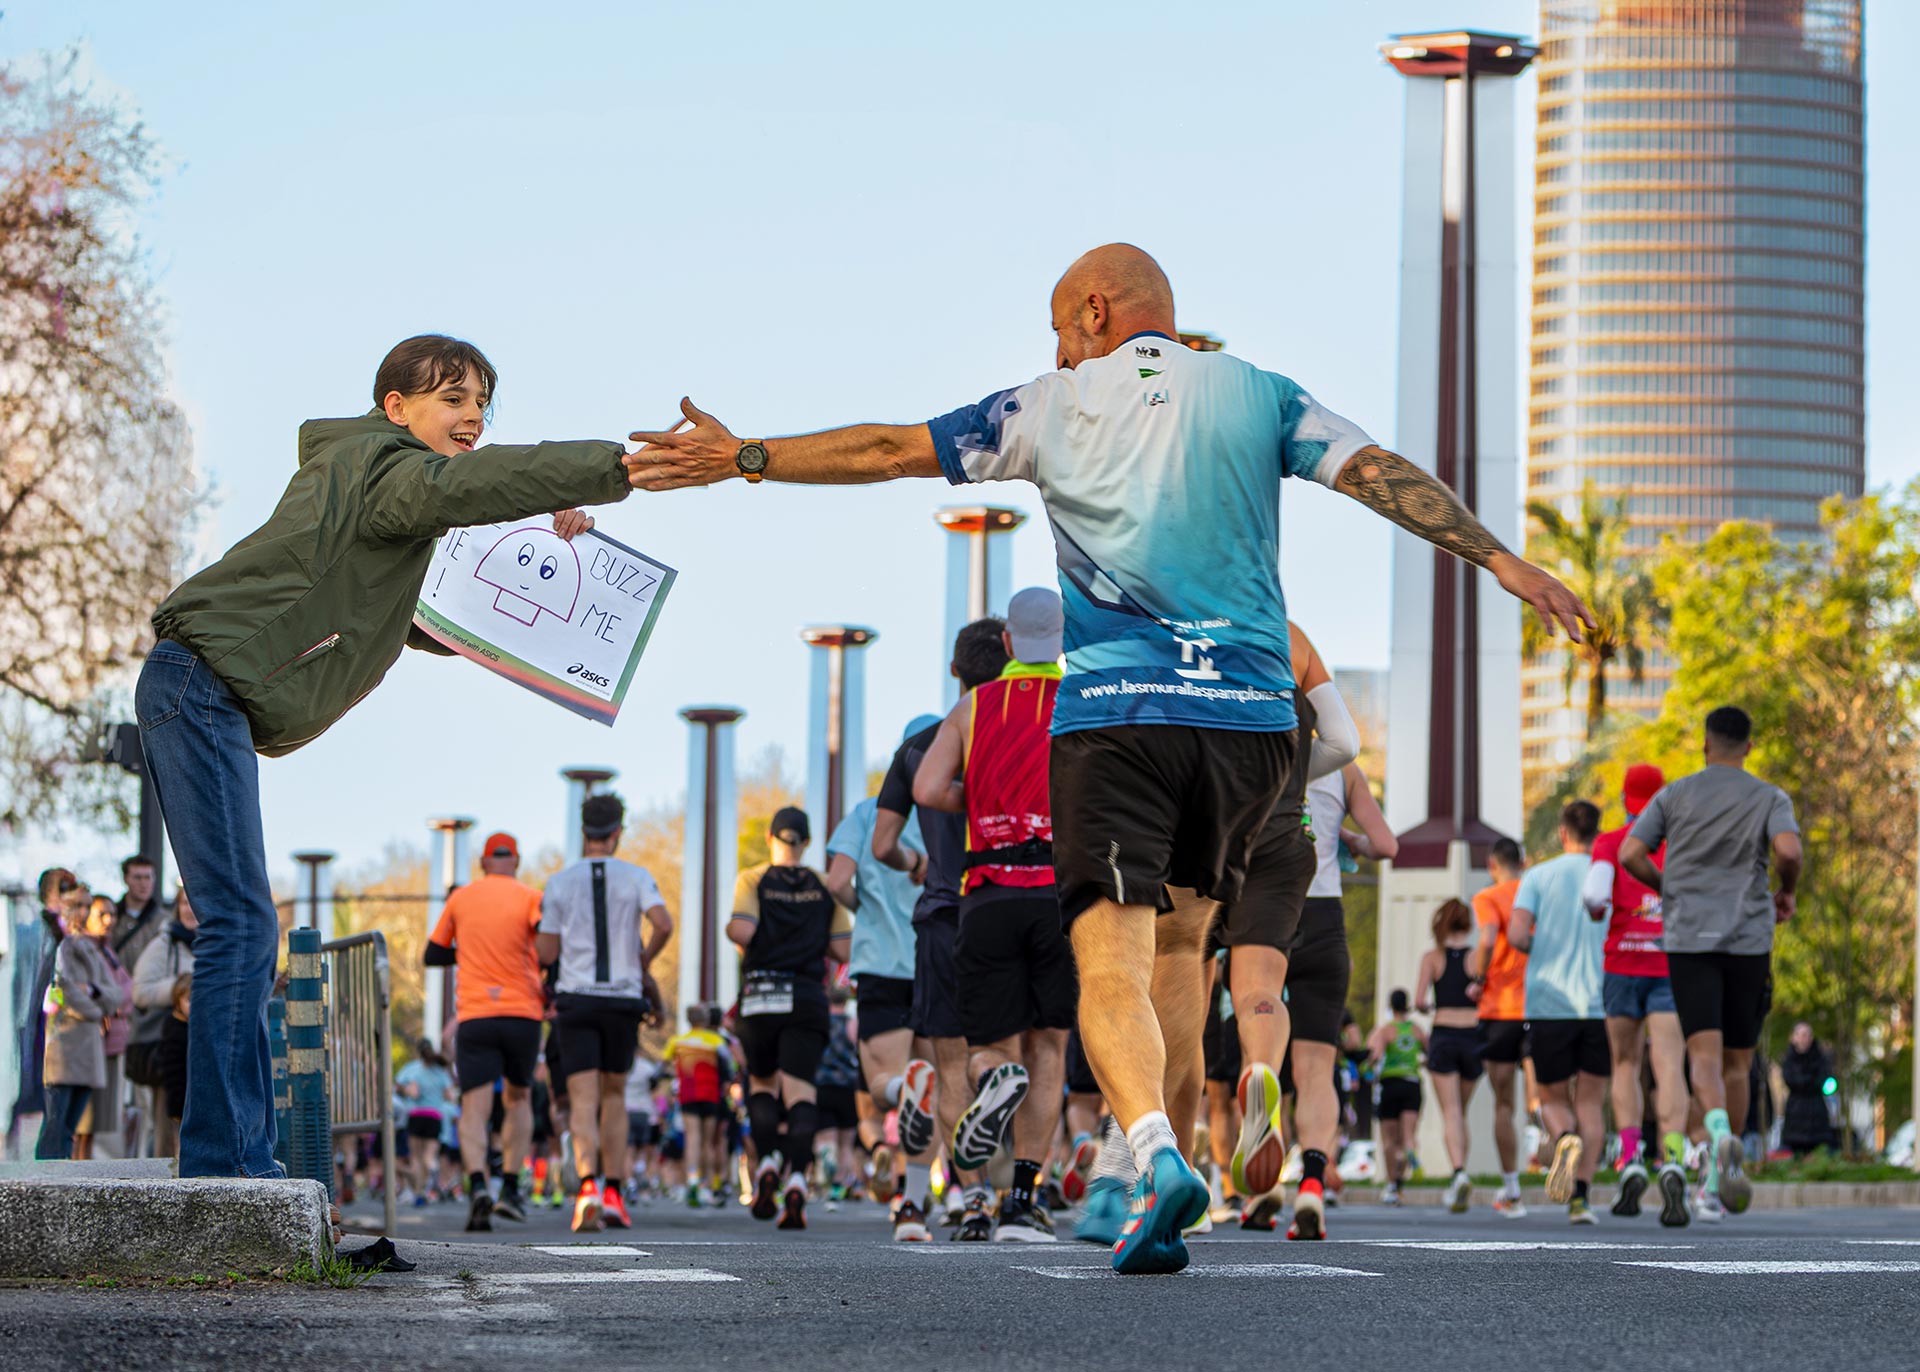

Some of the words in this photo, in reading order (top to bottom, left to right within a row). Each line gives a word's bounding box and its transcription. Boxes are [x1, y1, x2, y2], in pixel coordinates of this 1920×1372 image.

[590, 547, 657, 603] BUZZ
[426, 616, 440, 629] move
[438, 624, 453, 637] your
[452, 632, 469, 645] mind
[466, 639, 481, 653] with
[478, 648, 501, 662] ASICS
[579, 603, 622, 644] ME
